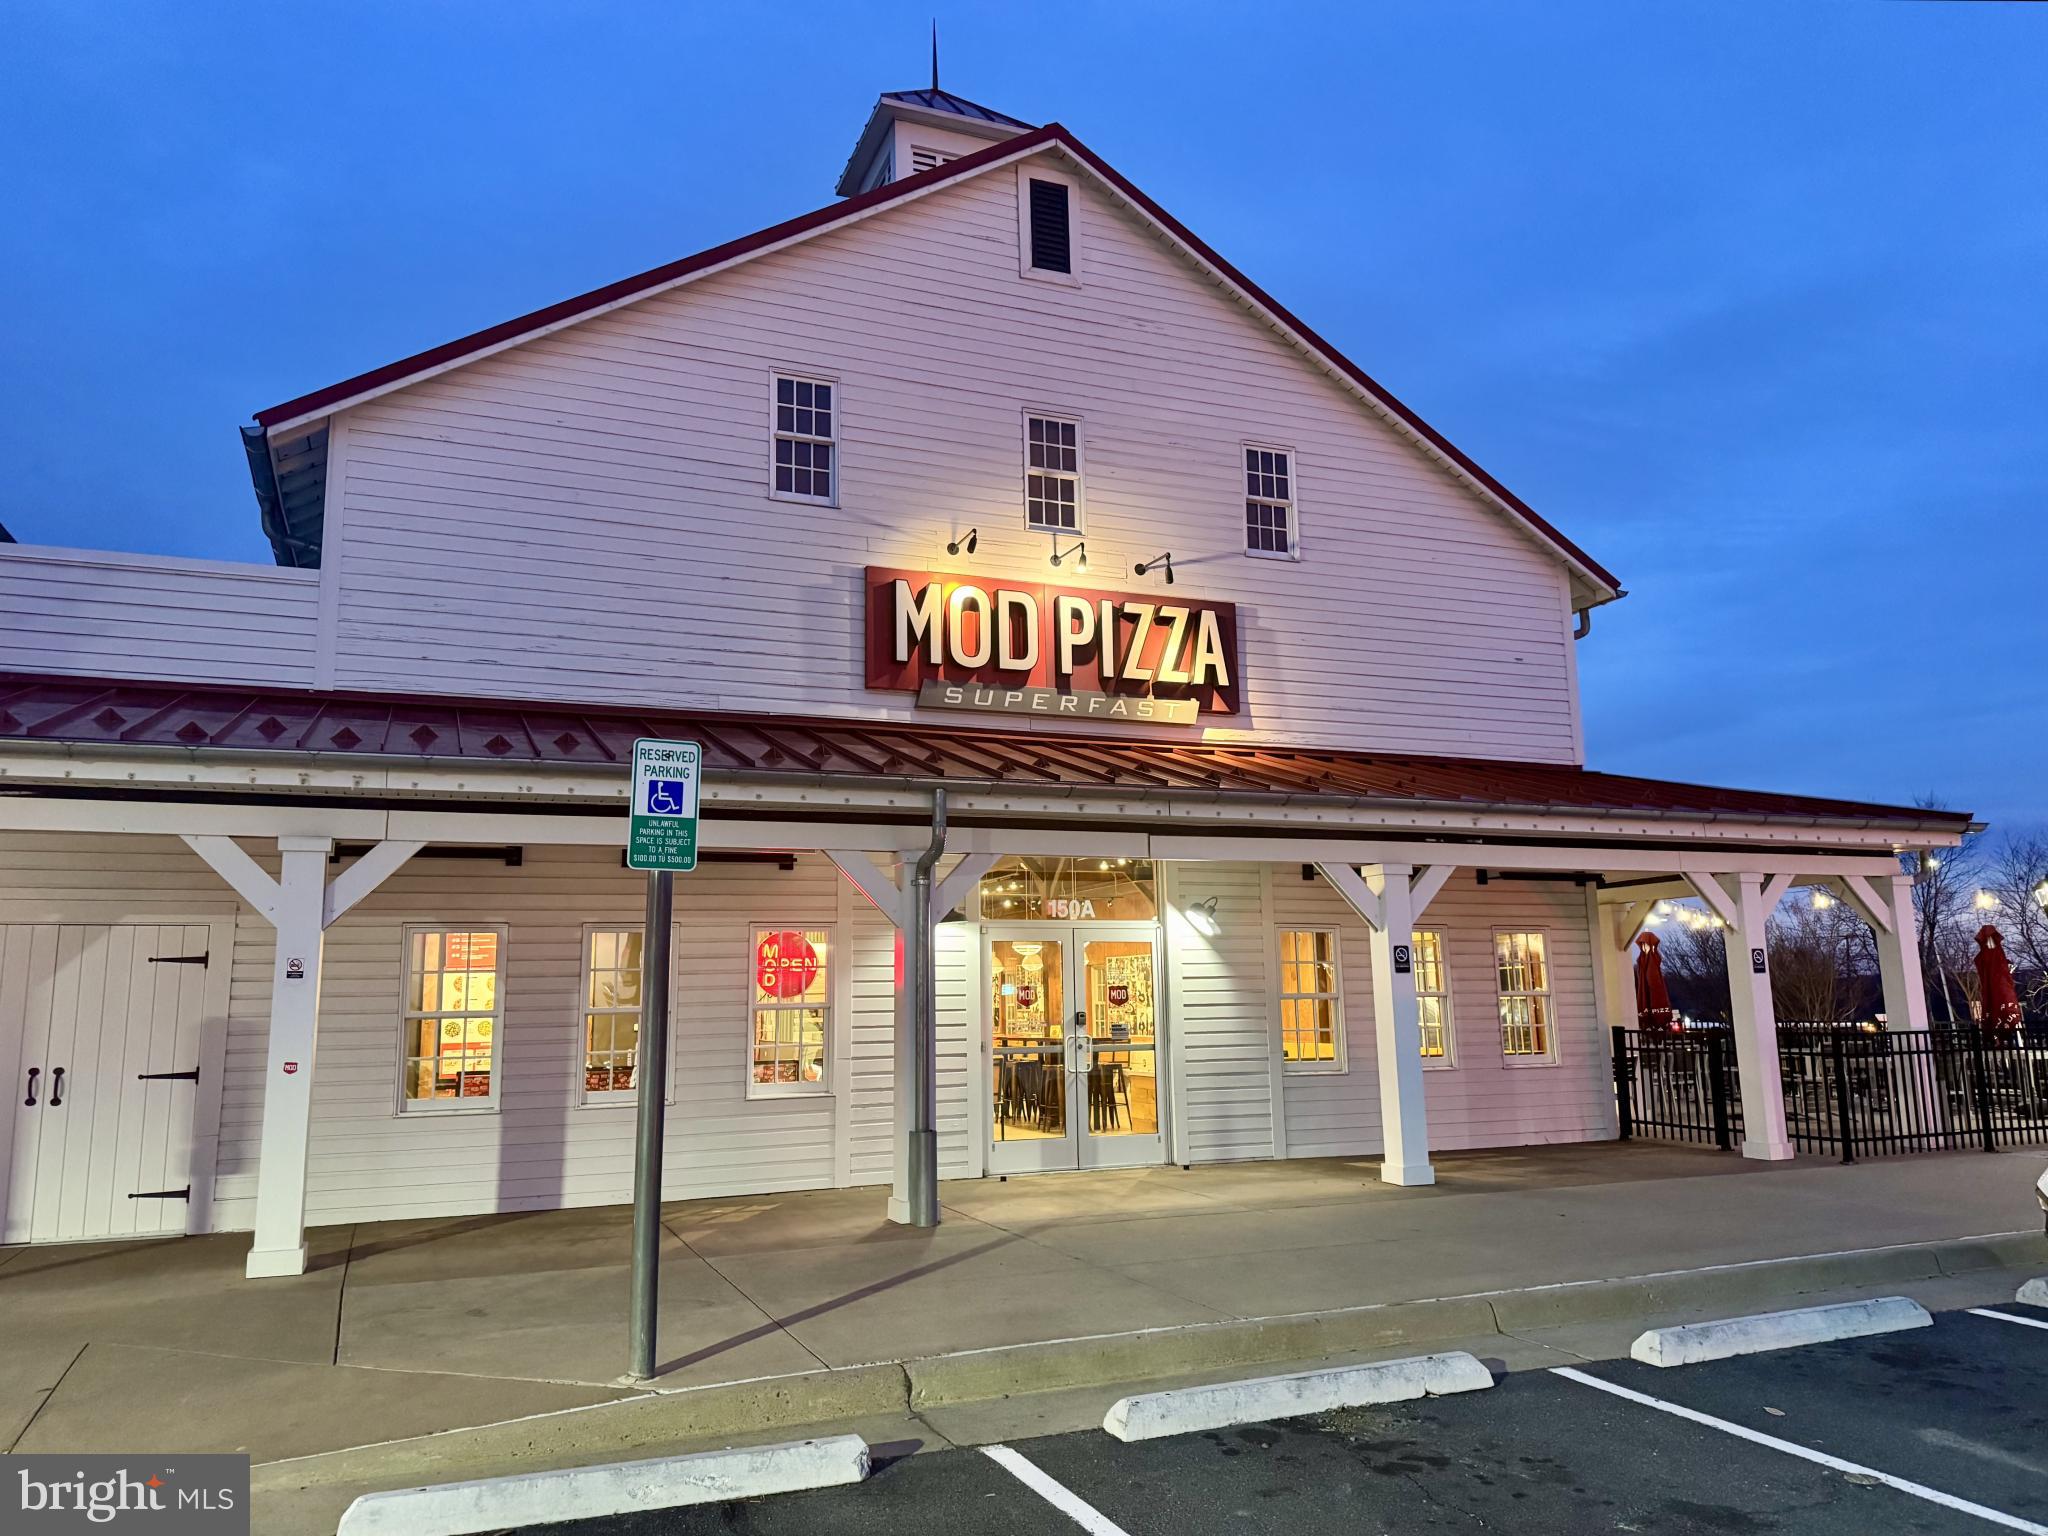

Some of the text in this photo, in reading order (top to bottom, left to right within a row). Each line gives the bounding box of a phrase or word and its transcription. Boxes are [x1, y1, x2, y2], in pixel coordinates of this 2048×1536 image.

[894, 578, 1230, 688] MOD PIZZA
[943, 686, 1185, 719] SUPERFAST
[640, 748, 696, 763] RESERVED
[644, 765, 690, 779] PARKING
[648, 820, 679, 828] UNLAWFUL
[639, 827, 665, 836] PARKING
[675, 830, 688, 838] THIS
[635, 836, 691, 846] SPACE IS SUBJECT
[648, 845, 678, 854] TO A FINE
[633, 854, 692, 864] $100.00 TO $500.00
[1047, 899, 1096, 919] 150A
[1018, 989, 1036, 1001] MOD
[1110, 989, 1127, 1000] MOD
